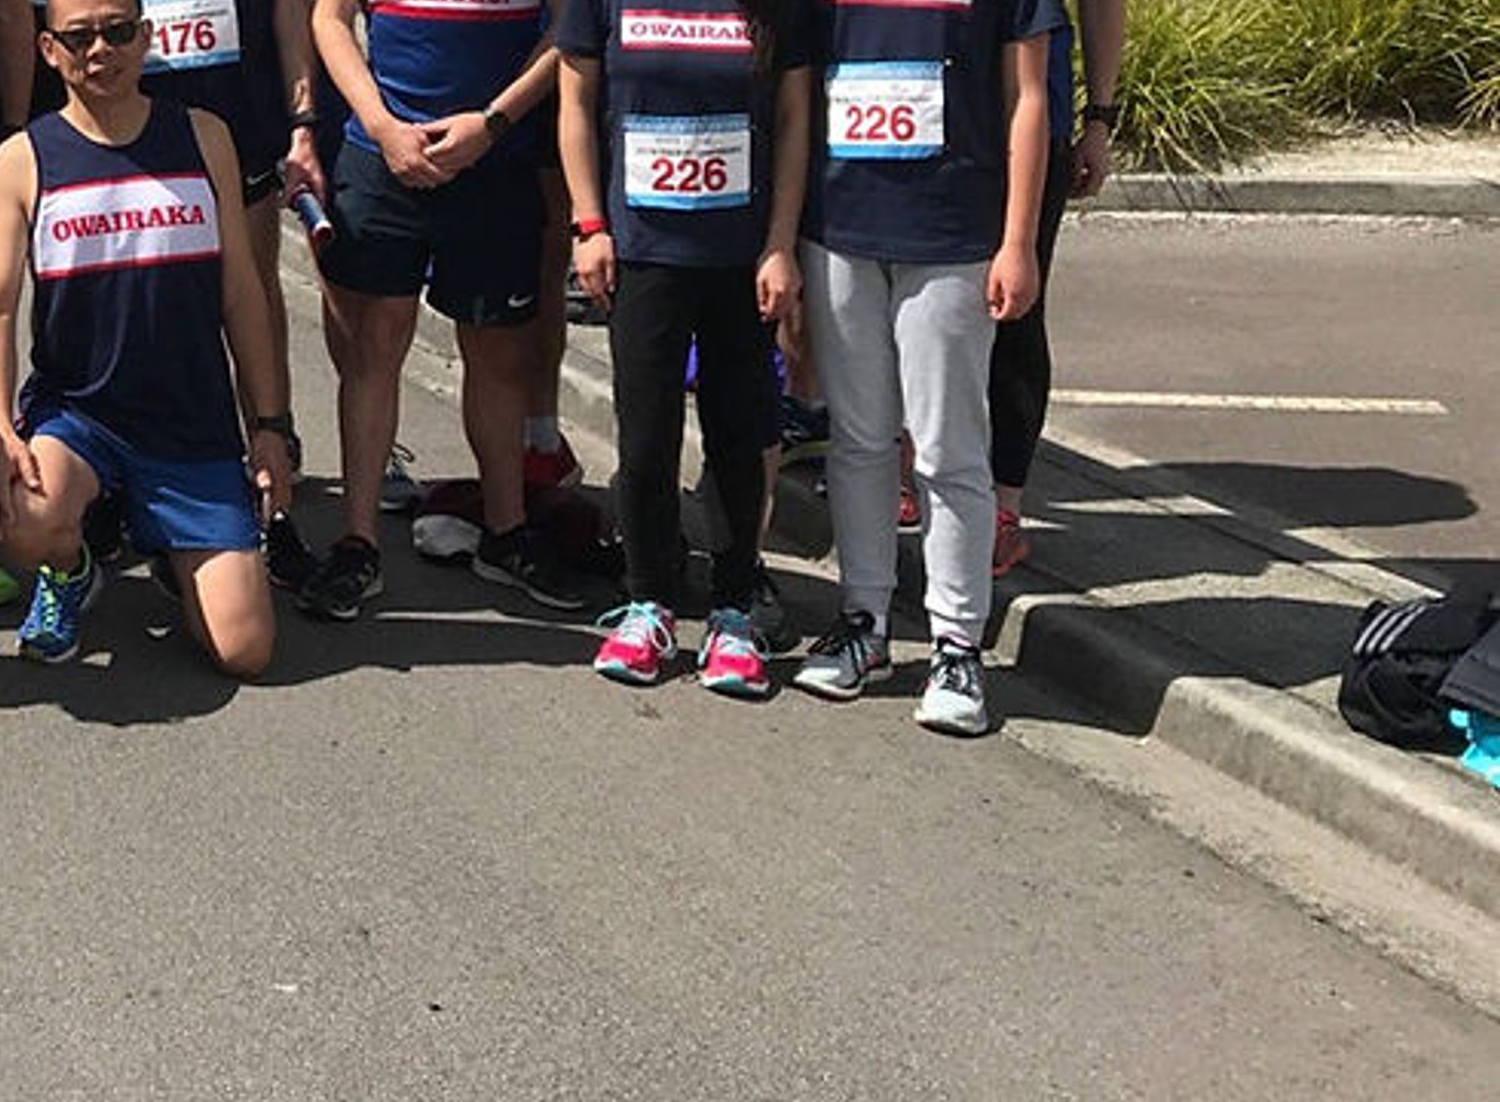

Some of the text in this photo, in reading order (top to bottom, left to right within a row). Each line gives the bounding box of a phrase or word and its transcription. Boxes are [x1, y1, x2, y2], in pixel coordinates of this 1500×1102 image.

[157, 20, 216, 55] 176
[630, 21, 752, 40] OWAIRAK
[845, 104, 916, 141] 226
[652, 158, 727, 191] 226
[52, 204, 206, 241] OWAIRAKA
